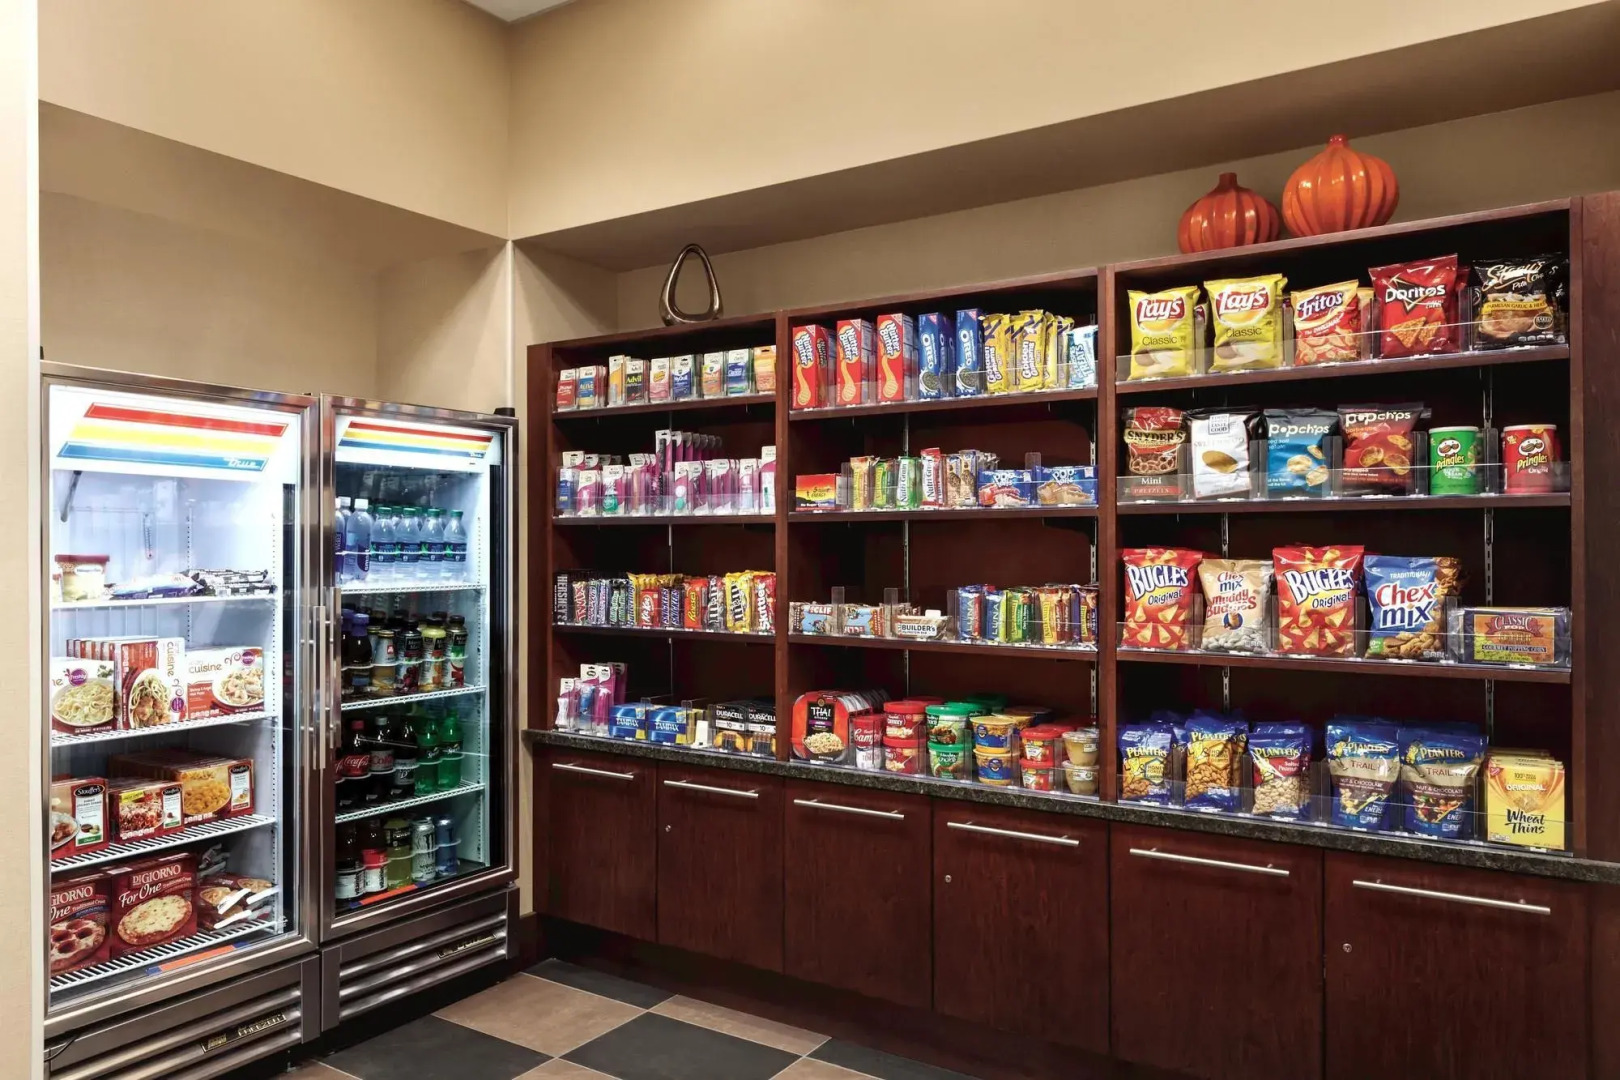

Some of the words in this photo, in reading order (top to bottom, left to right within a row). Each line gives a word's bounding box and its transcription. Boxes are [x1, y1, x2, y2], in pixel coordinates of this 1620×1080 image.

[1219, 286, 1266, 315] Lay's
[1385, 284, 1446, 303] Doritos
[1139, 296, 1183, 323] Lay's
[1296, 290, 1343, 321] Fritos
[886, 321, 900, 352] Nutter
[1225, 326, 1262, 338] Classic
[802, 332, 814, 361] Nutter
[838, 335, 852, 361] Butter
[846, 326, 859, 357] Nutter
[879, 329, 894, 356] Butter
[961, 329, 972, 366] OREO
[1142, 335, 1177, 346] Classic
[795, 339, 808, 367] Butter
[922, 333, 934, 369] OREO
[1028, 341, 1038, 376] Grahams
[1022, 341, 1031, 379] Golden
[1076, 343, 1094, 377] TREATS
[1345, 411, 1411, 426] popchips
[1127, 430, 1183, 441] SNYDER'S
[1268, 423, 1329, 437] popchips
[1436, 454, 1464, 472] Pringles
[1517, 453, 1548, 472] Pringles
[926, 478, 935, 498] Nutri
[1141, 477, 1162, 485] Mini
[1127, 564, 1188, 600] BUGLES
[1217, 571, 1244, 583] Chex
[1219, 579, 1244, 592] mix
[1284, 568, 1354, 605] BUGLES
[557, 575, 567, 621] HERSHEY'S
[1148, 590, 1183, 605] Original
[1312, 593, 1351, 609] Original
[1376, 582, 1435, 607] Chex
[813, 606, 832, 614] CLIF
[1381, 602, 1434, 627] mix
[1494, 615, 1533, 630] CLASSIC
[189, 663, 222, 673] cuisine
[716, 710, 743, 719] DURACELL
[748, 713, 776, 722] DURACELL
[810, 706, 831, 717] THAI
[616, 717, 639, 727] TAMPAX
[655, 722, 679, 732] TAMPAX
[1126, 746, 1167, 757] PLANTERS
[1255, 747, 1300, 757] PLANTERS
[1420, 747, 1465, 758] PLANTERS
[1351, 760, 1375, 770] TRAIL
[1427, 767, 1451, 776] TRAIL
[77, 786, 102, 797] Stouffer's
[1507, 809, 1545, 825] Wheat
[1505, 822, 1545, 834] Thins
[132, 864, 181, 886] DIGIORNO
[119, 891, 138, 908] For
[139, 882, 162, 900] One
